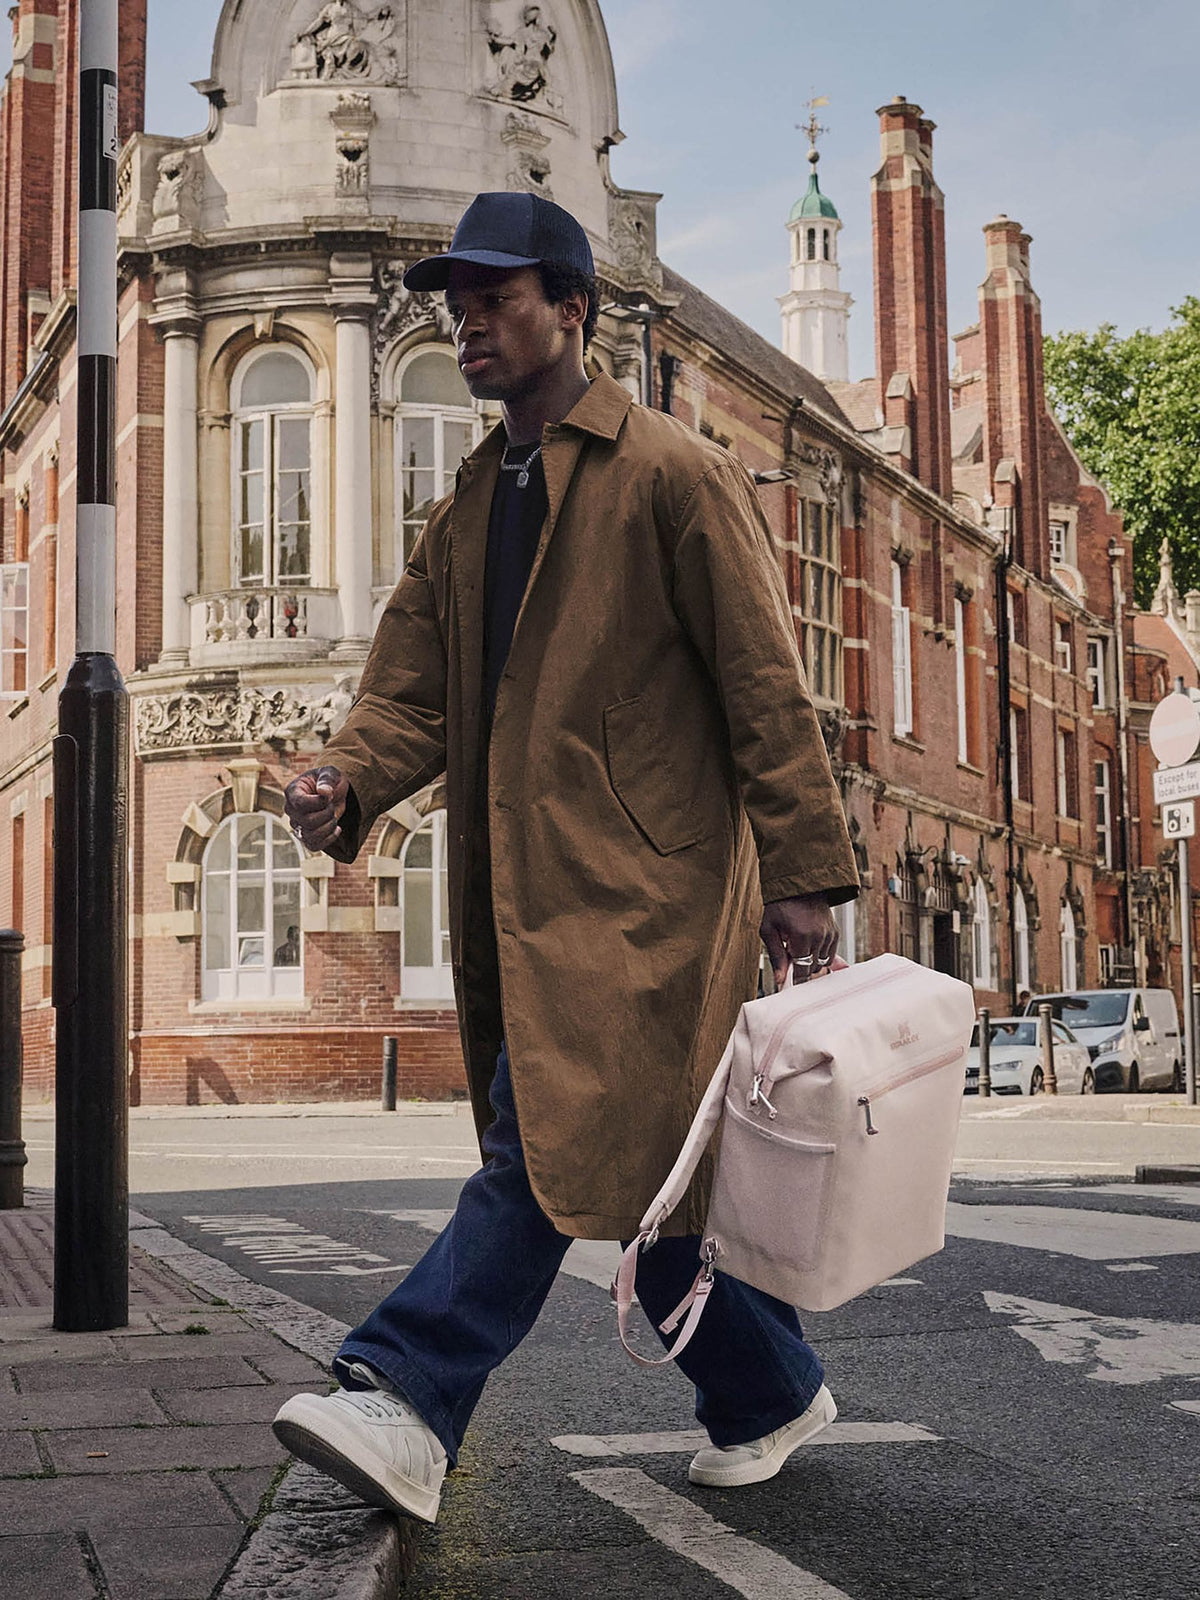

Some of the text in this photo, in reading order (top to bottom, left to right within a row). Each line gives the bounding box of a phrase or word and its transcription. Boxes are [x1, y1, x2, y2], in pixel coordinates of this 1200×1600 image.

[1159, 769, 1198, 785] Except for
[1158, 781, 1200, 798] local buses
